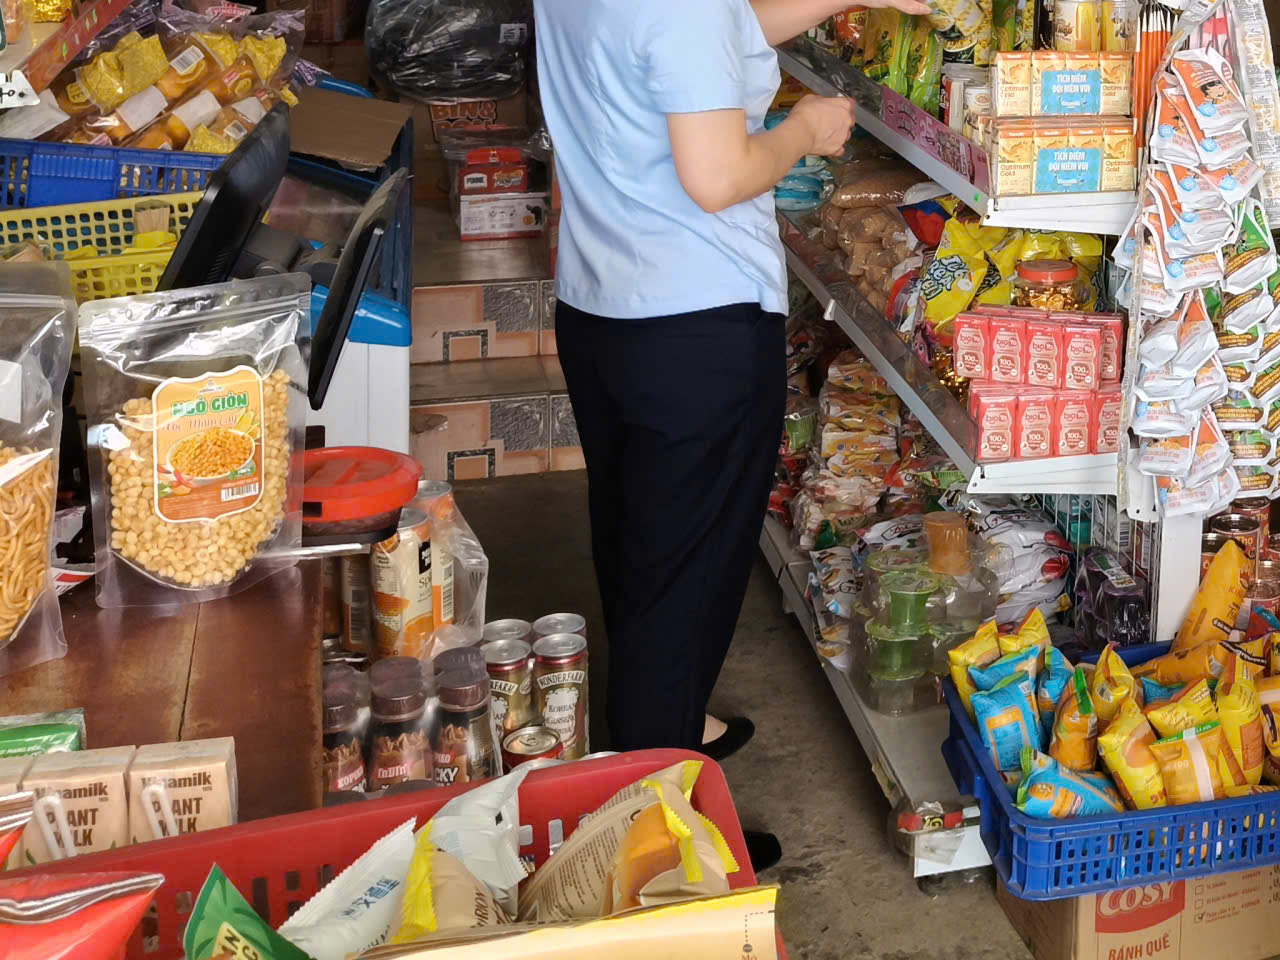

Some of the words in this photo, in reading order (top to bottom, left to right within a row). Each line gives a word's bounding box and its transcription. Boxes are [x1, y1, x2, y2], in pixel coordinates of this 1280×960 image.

[152, 797, 203, 814] PANT
[46, 808, 99, 827] PANT
[158, 817, 197, 837] MLK
[54, 828, 93, 848] MLK
[1099, 882, 1178, 917] COSY
[1108, 944, 1143, 960] BÁNH
